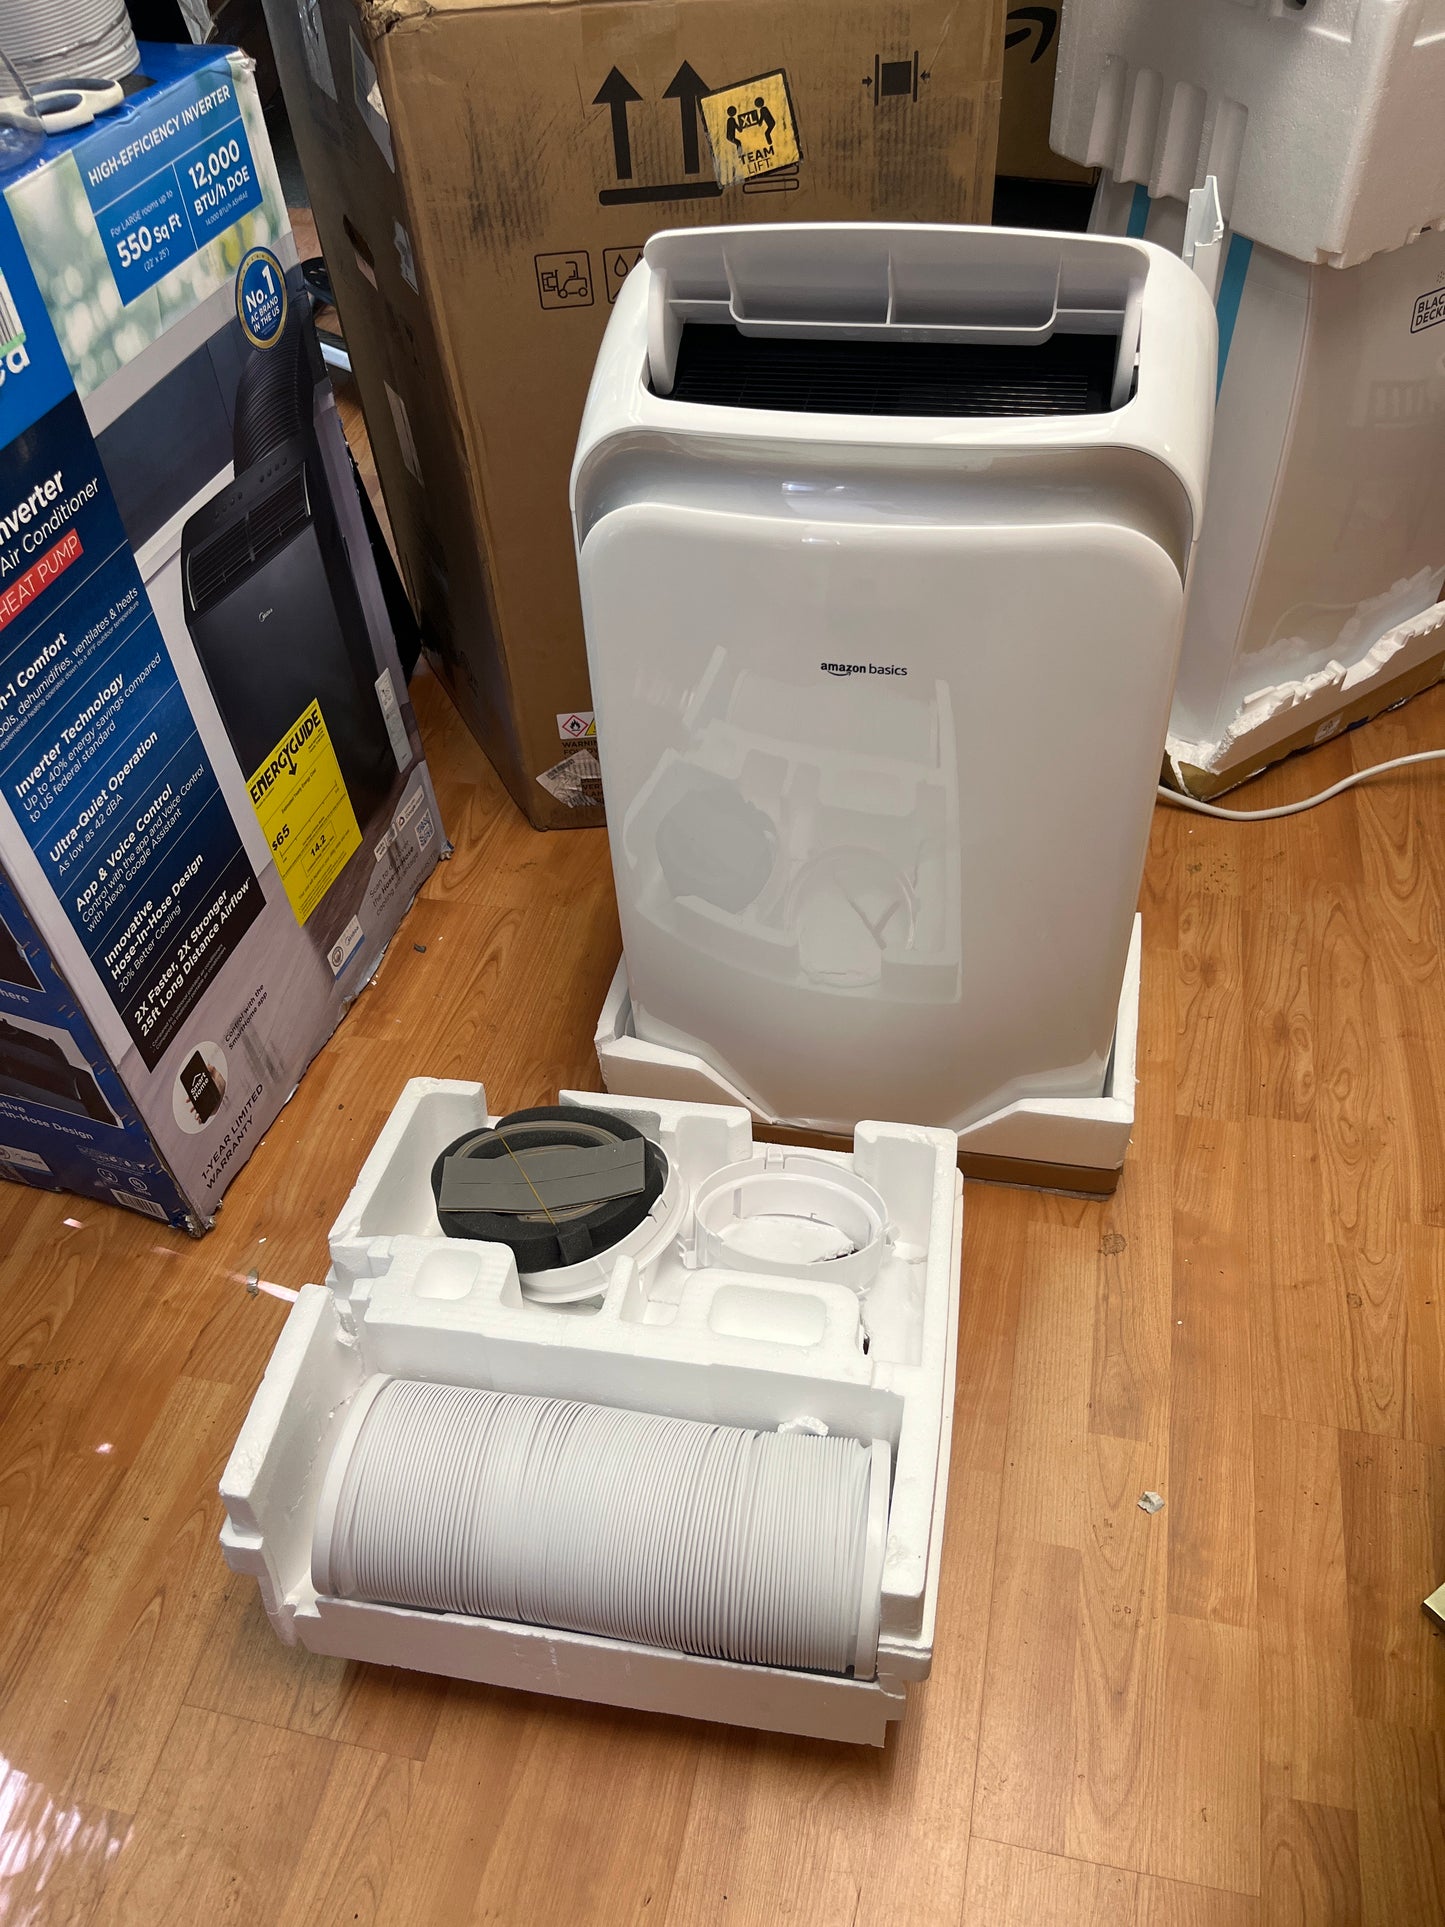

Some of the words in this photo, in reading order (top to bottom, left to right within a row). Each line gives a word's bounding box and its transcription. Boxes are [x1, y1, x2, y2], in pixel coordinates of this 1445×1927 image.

[87, 115, 180, 187] HIGH-EFFICIENCY
[182, 84, 231, 126] INVERTER
[740, 113, 757, 127] XL
[188, 139, 240, 190] 12,000
[738, 145, 775, 165] TEAM
[747, 157, 771, 175] LIFT
[110, 225, 121, 238] For
[121, 210, 142, 231] LARGE
[141, 200, 160, 217] rooms
[158, 194, 167, 206] up
[165, 189, 173, 199] to
[193, 183, 226, 217] BTU/h
[227, 165, 250, 193] DOE
[116, 225, 152, 268] 550
[168, 212, 183, 233] Ft
[245, 289, 268, 313] No.
[261, 265, 275, 295] 1
[250, 312, 260, 325] AC
[259, 295, 279, 317] BRAND
[253, 324, 261, 334] IN
[260, 314, 273, 328] THE
[271, 305, 280, 318] US
[1, 547, 21, 574] Air
[22, 476, 100, 553] Conditioner
[39, 535, 79, 581] PUMP
[16, 632, 68, 688] Comfort
[18, 657, 73, 714] dehumidifies,
[72, 617, 110, 657] ventilates
[109, 608, 117, 620] &
[116, 587, 139, 613] heats
[821, 662, 866, 676] amazon
[868, 663, 908, 676] basics
[15, 742, 62, 798] Inverter
[60, 673, 124, 746] Technology
[23, 794, 38, 811] Up
[37, 782, 48, 797] to
[49, 758, 68, 782] 40%
[67, 729, 95, 763] energy
[95, 697, 125, 731] savings
[124, 652, 161, 698] compared
[249, 708, 321, 805] ENERGYGUIDE
[30, 810, 41, 824] to
[39, 792, 55, 811] US
[53, 759, 82, 797] federal
[81, 720, 117, 764] standard
[49, 788, 109, 863] Ultra-Quiet
[107, 731, 159, 792] Operation
[57, 863, 71, 877] As
[69, 841, 85, 862] low
[83, 829, 96, 844] as
[94, 814, 106, 830] 42
[105, 793, 125, 817] dBA
[75, 880, 100, 913] App
[98, 867, 108, 881] &
[106, 831, 137, 868] Voice
[135, 783, 174, 833] Control
[81, 884, 109, 923] Control
[107, 867, 125, 891] with
[123, 853, 136, 870] the
[134, 834, 150, 856] app
[149, 817, 163, 837] and
[161, 795, 182, 818] Voice
[180, 763, 205, 797] Control
[272, 823, 290, 851] $65
[310, 835, 326, 857] 14.2
[86, 909, 105, 934] with
[104, 883, 127, 912] Alexa,
[125, 848, 152, 882] Google
[150, 808, 183, 850] Assistant
[104, 899, 154, 967] Innovative
[110, 895, 173, 980] Hose-In-Hose
[171, 854, 204, 896] Design
[118, 969, 135, 993] 20%
[133, 939, 156, 972] Better
[134, 1001, 149, 1024] 2X
[147, 961, 179, 1004] Faster,
[177, 939, 191, 962] 2X
[190, 889, 228, 943] Stronger
[140, 1006, 161, 1037] 25ft
[159, 974, 184, 1008] Long
[182, 923, 220, 976] Distance
[225, 1012, 244, 1042] Control
[243, 997, 256, 1015] with
[254, 984, 264, 998] the
[229, 1006, 257, 1050] SmartHome
[257, 991, 268, 1007] app
[190, 1072, 206, 1096] Smart
[193, 1077, 209, 1101] Home
[52, 1122, 94, 1140] Design
[202, 1134, 231, 1179] 1-YEAR
[231, 1083, 264, 1135] LIMITED
[206, 1115, 254, 1190] WARRANTY
